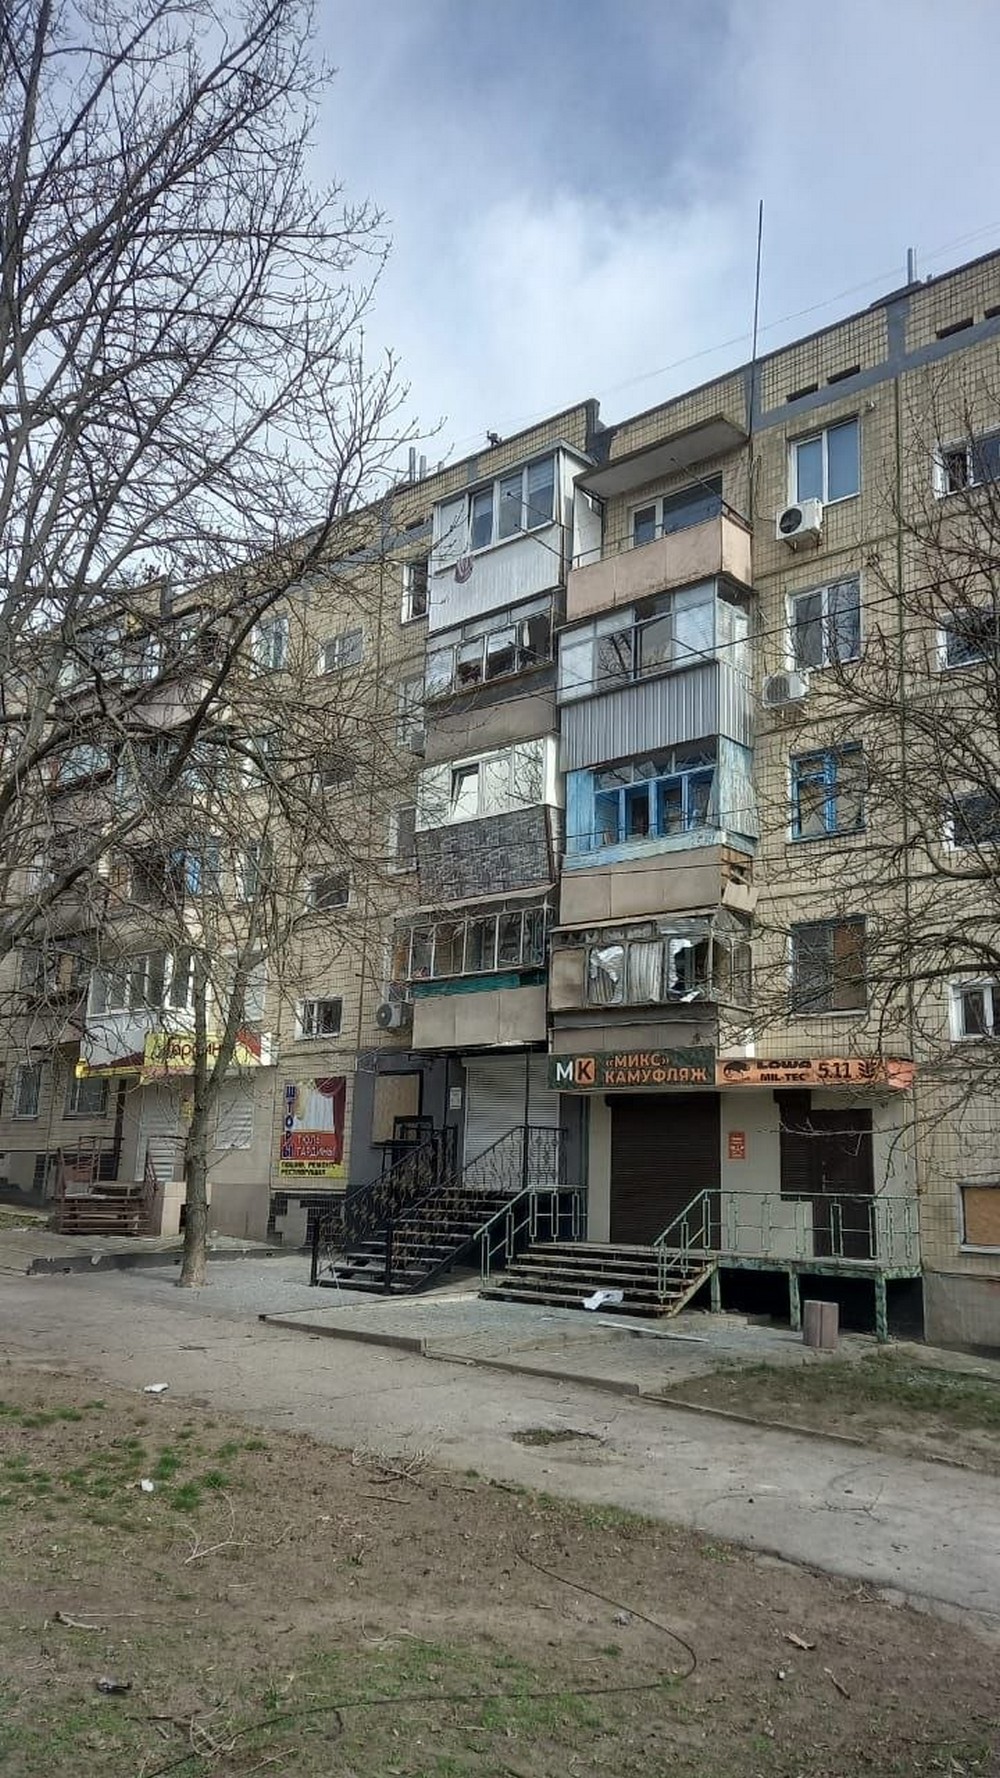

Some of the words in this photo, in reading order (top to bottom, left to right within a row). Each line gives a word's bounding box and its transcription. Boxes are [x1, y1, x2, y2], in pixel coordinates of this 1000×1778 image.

[606, 1054, 669, 1068] «МИКС»
[757, 1060, 811, 1069] LOWA
[605, 1067, 707, 1083] КАМУФЛЯЖ
[818, 1062, 851, 1079] 5.11
[283, 1085, 296, 1157] ШТОРЫ
